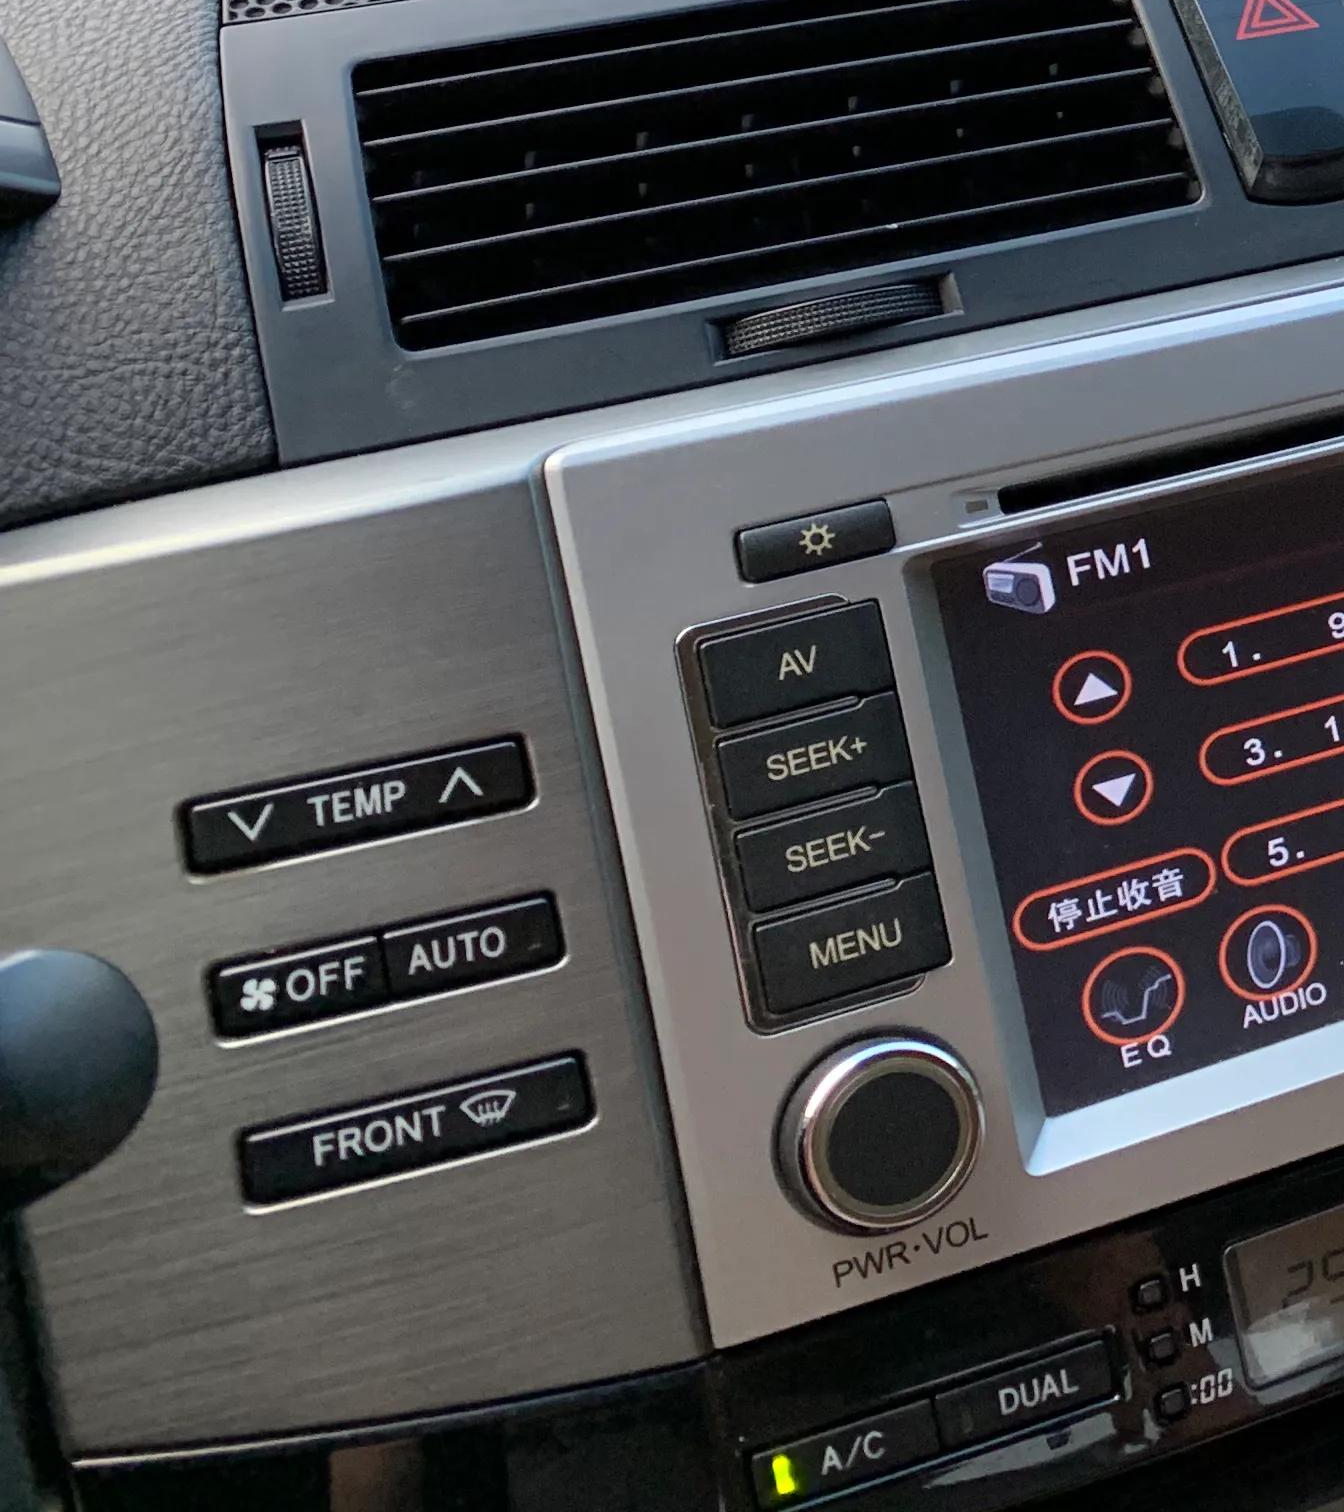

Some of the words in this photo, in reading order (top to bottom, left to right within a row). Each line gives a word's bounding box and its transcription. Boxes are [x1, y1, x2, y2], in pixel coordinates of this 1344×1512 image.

[1067, 538, 1152, 587] FM1
[778, 645, 817, 681] AV
[1221, 640, 1261, 668] 1.
[766, 735, 868, 782] SEEK+
[1243, 737, 1283, 768] 3.
[306, 780, 407, 828] TEMP
[1267, 836, 1306, 867] 5.
[1046, 867, 1185, 934] 停止收音
[407, 926, 507, 976] AUTO
[808, 918, 903, 969] MENU
[286, 956, 365, 1002] OFF
[1242, 982, 1328, 1029] AUDIO
[1120, 1032, 1173, 1069] EQ
[312, 1104, 447, 1167] FRONT
[1179, 1263, 1201, 1292] H
[1188, 1318, 1214, 1348] M
[998, 1368, 1080, 1417] DUAL
[820, 1430, 885, 1477] A/C
